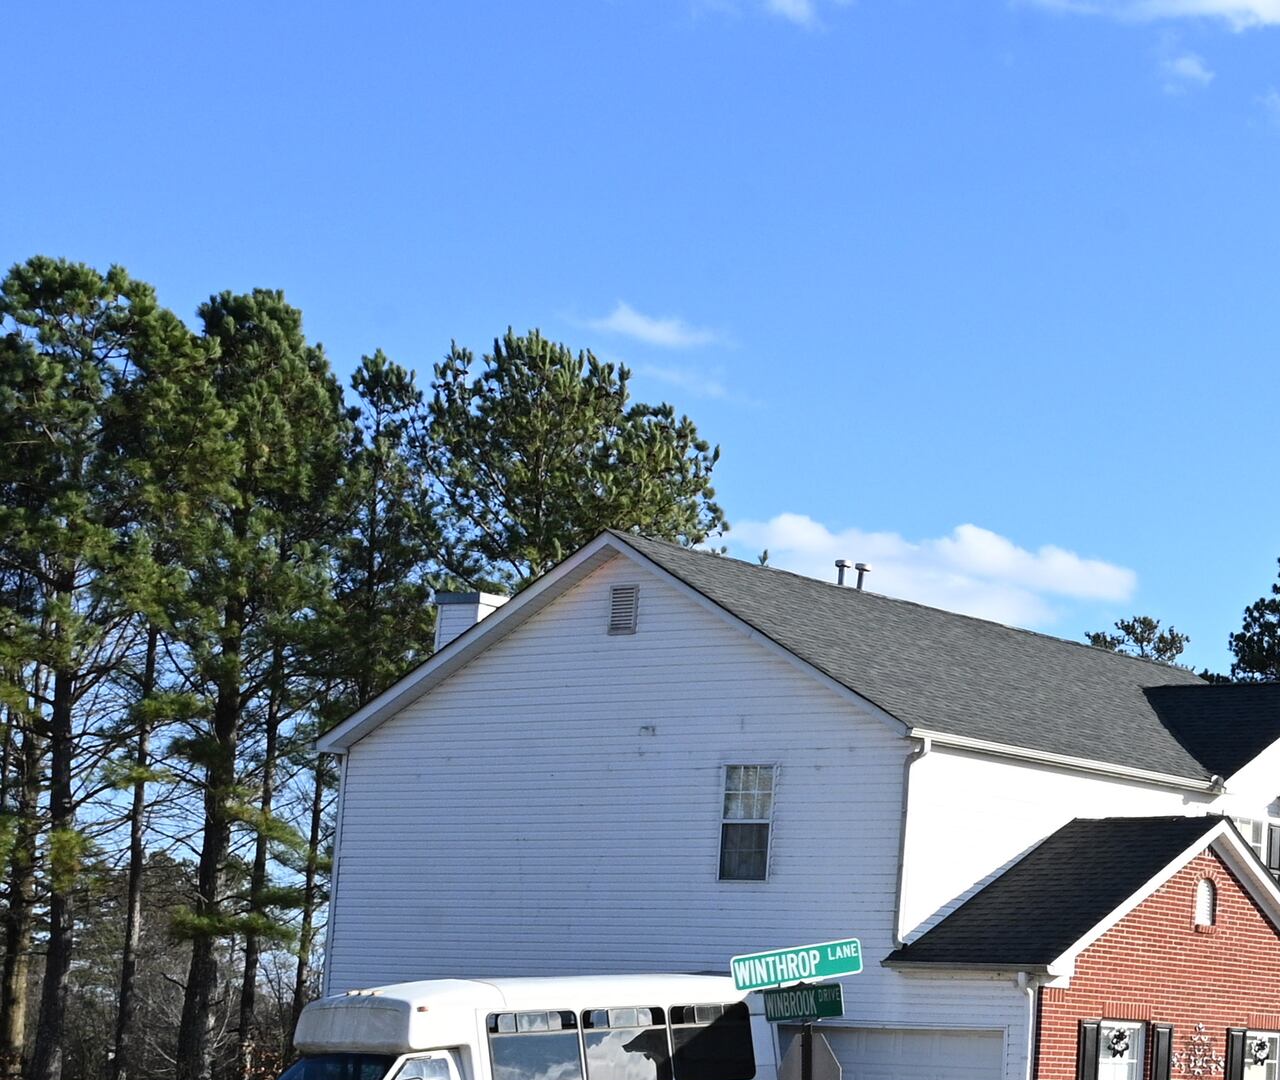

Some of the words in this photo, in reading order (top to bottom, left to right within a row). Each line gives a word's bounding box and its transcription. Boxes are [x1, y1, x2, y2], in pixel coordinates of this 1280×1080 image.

[733, 949, 820, 987] WINTHROP
[827, 943, 859, 961] LANE
[765, 989, 818, 1019] WINBROOK
[818, 987, 841, 1002] DRIVE
